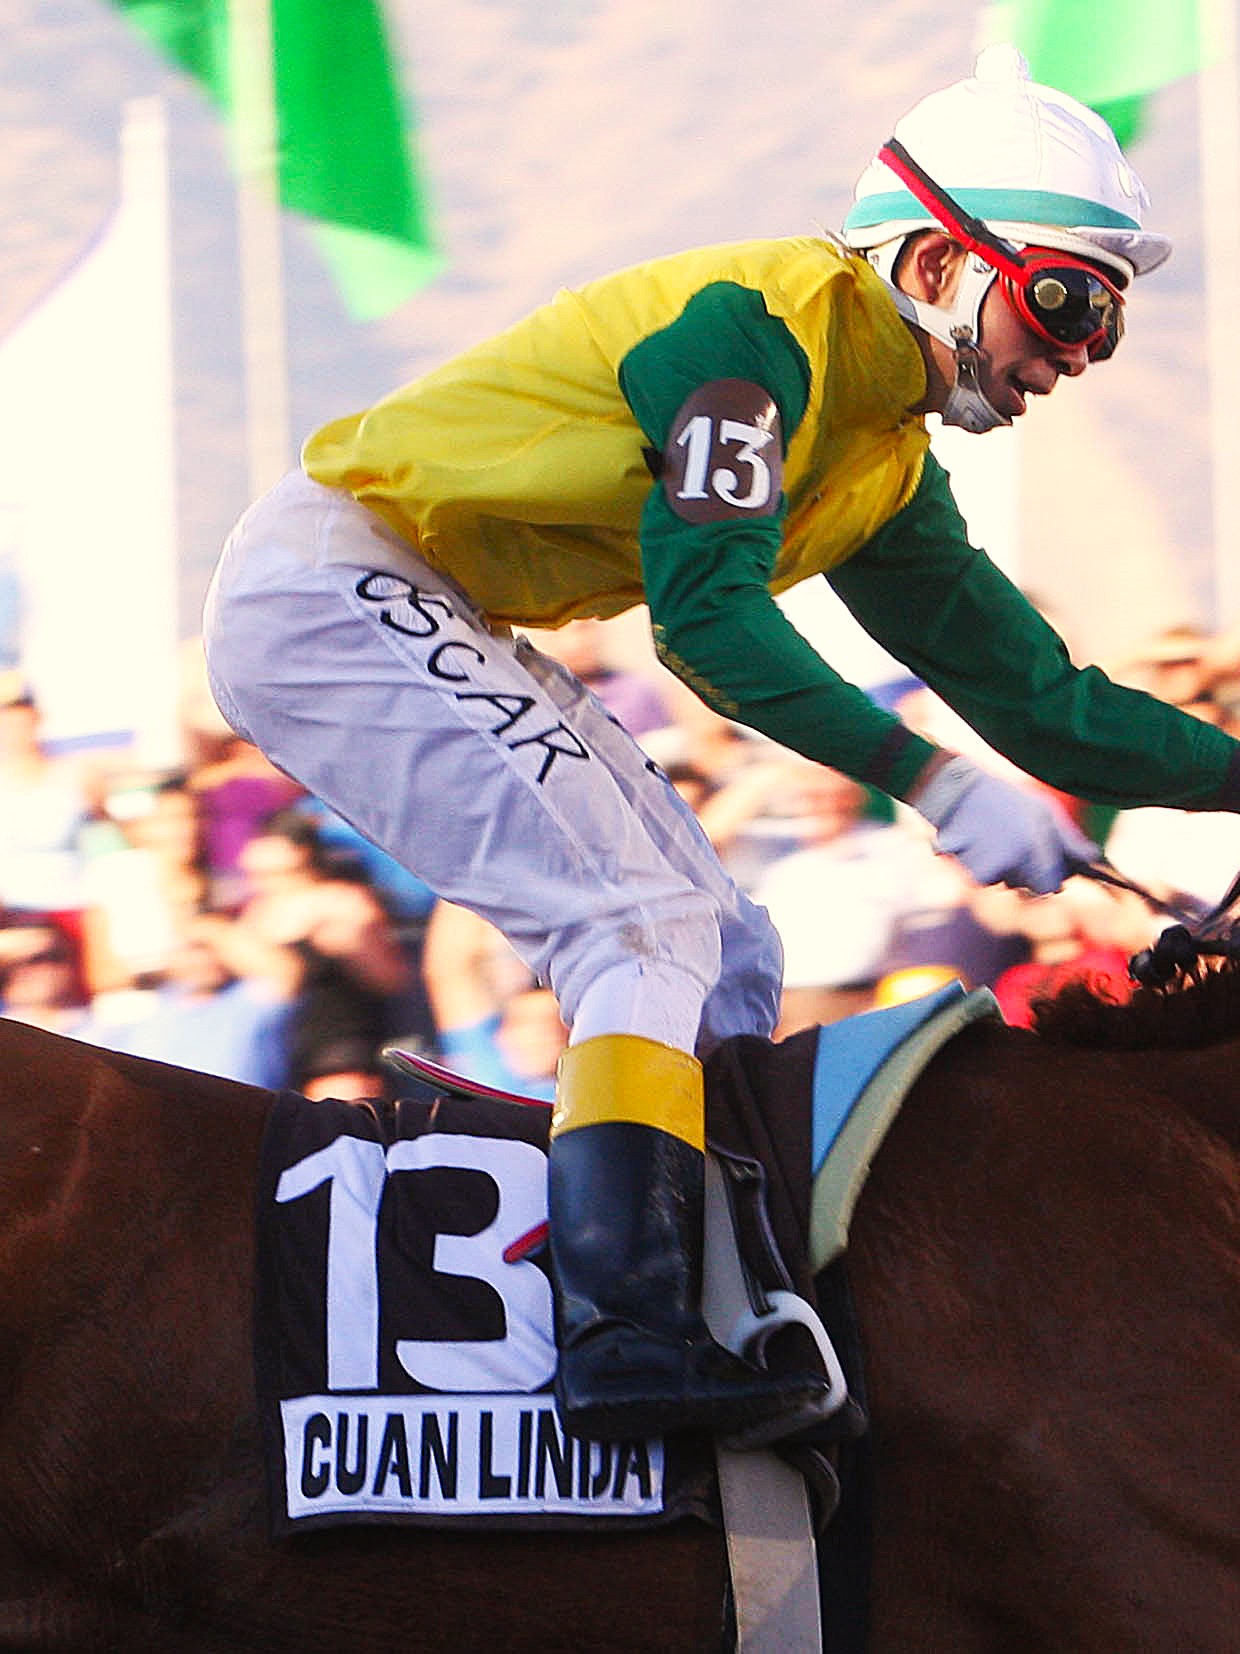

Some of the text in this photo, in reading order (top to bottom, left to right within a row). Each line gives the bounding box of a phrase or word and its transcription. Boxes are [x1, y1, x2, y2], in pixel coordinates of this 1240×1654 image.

[676, 415, 775, 509] 13
[355, 571, 590, 784] OSCAR
[275, 1132, 559, 1392] 13
[300, 1409, 653, 1500] CUAN LINDA
